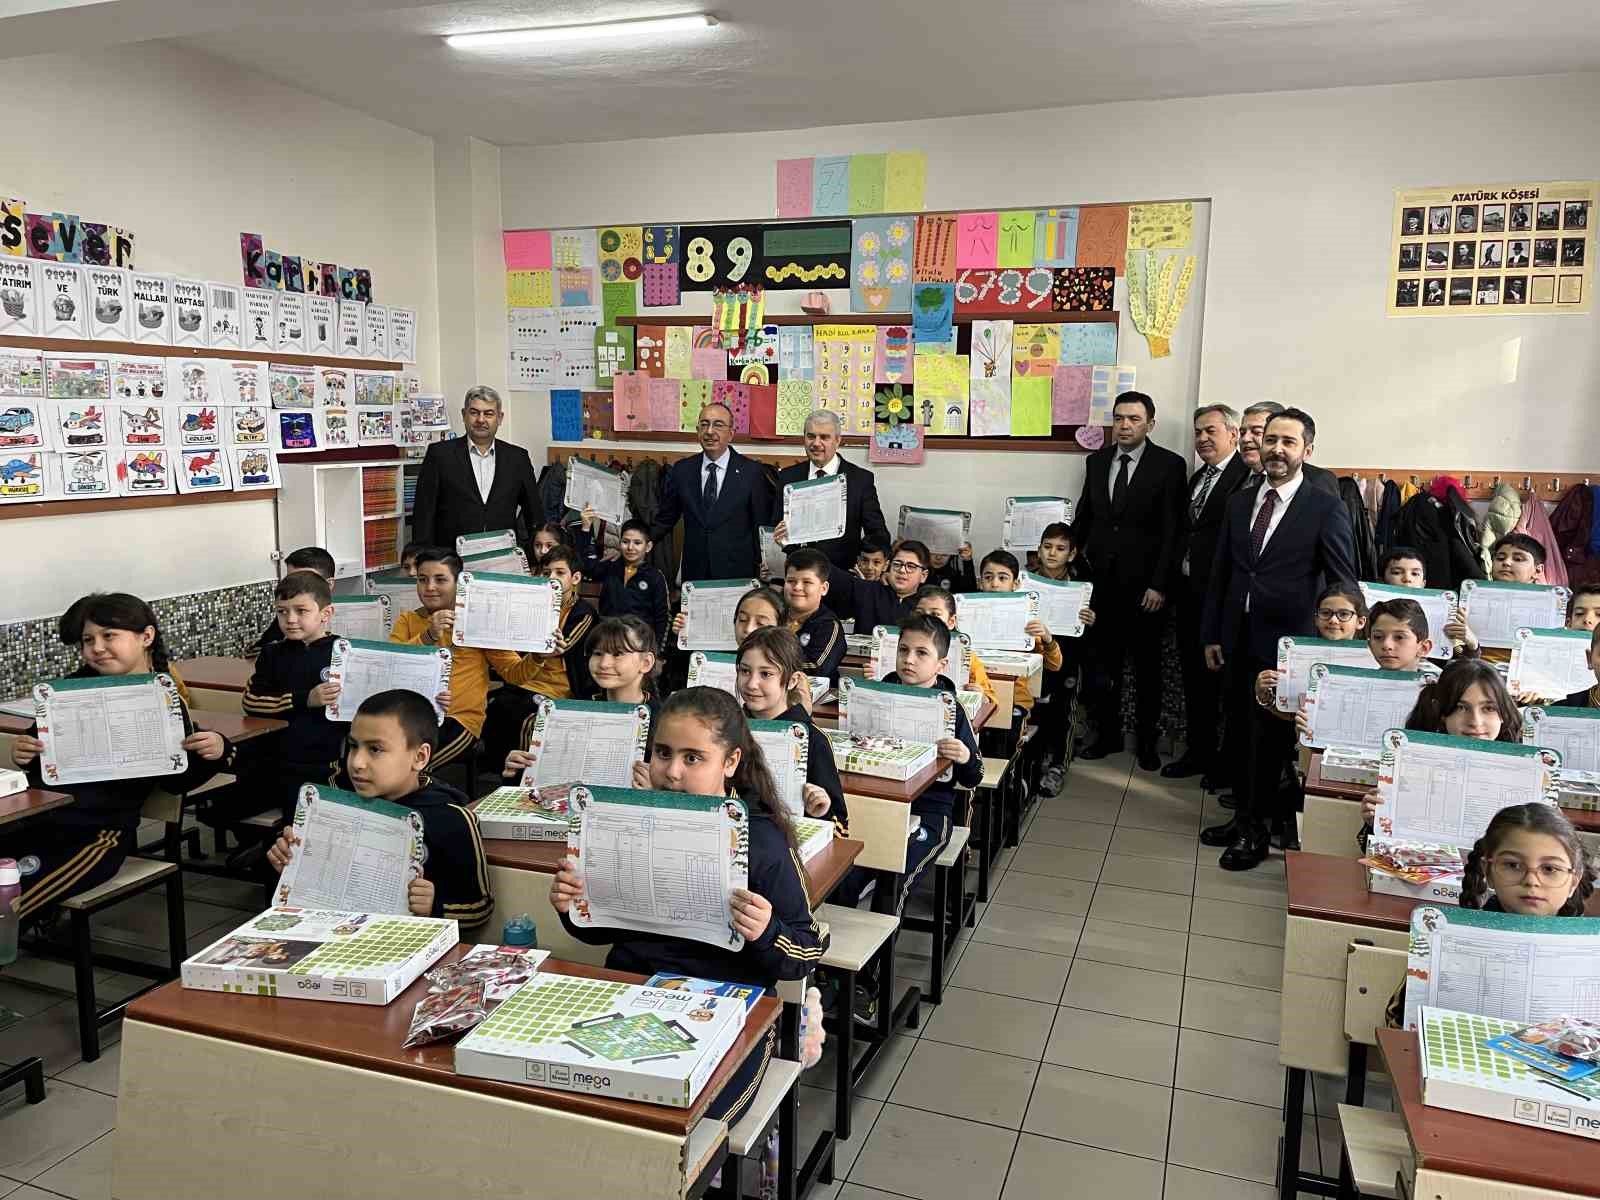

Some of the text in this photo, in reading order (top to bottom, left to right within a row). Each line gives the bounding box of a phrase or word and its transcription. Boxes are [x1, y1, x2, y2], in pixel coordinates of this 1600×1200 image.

[1451, 190, 1498, 202] ATATÜRK
[1501, 187, 1540, 201] KÖŞESİ
[686, 237, 753, 282] 8 9
[0, 276, 32, 289] ATIRIM
[57, 283, 68, 293] VE
[97, 285, 119, 297] TÜRK
[133, 292, 168, 304] MALLARI
[174, 296, 205, 308] HAFTASI
[641, 989, 693, 1002] mega
[572, 1072, 611, 1089] mega
